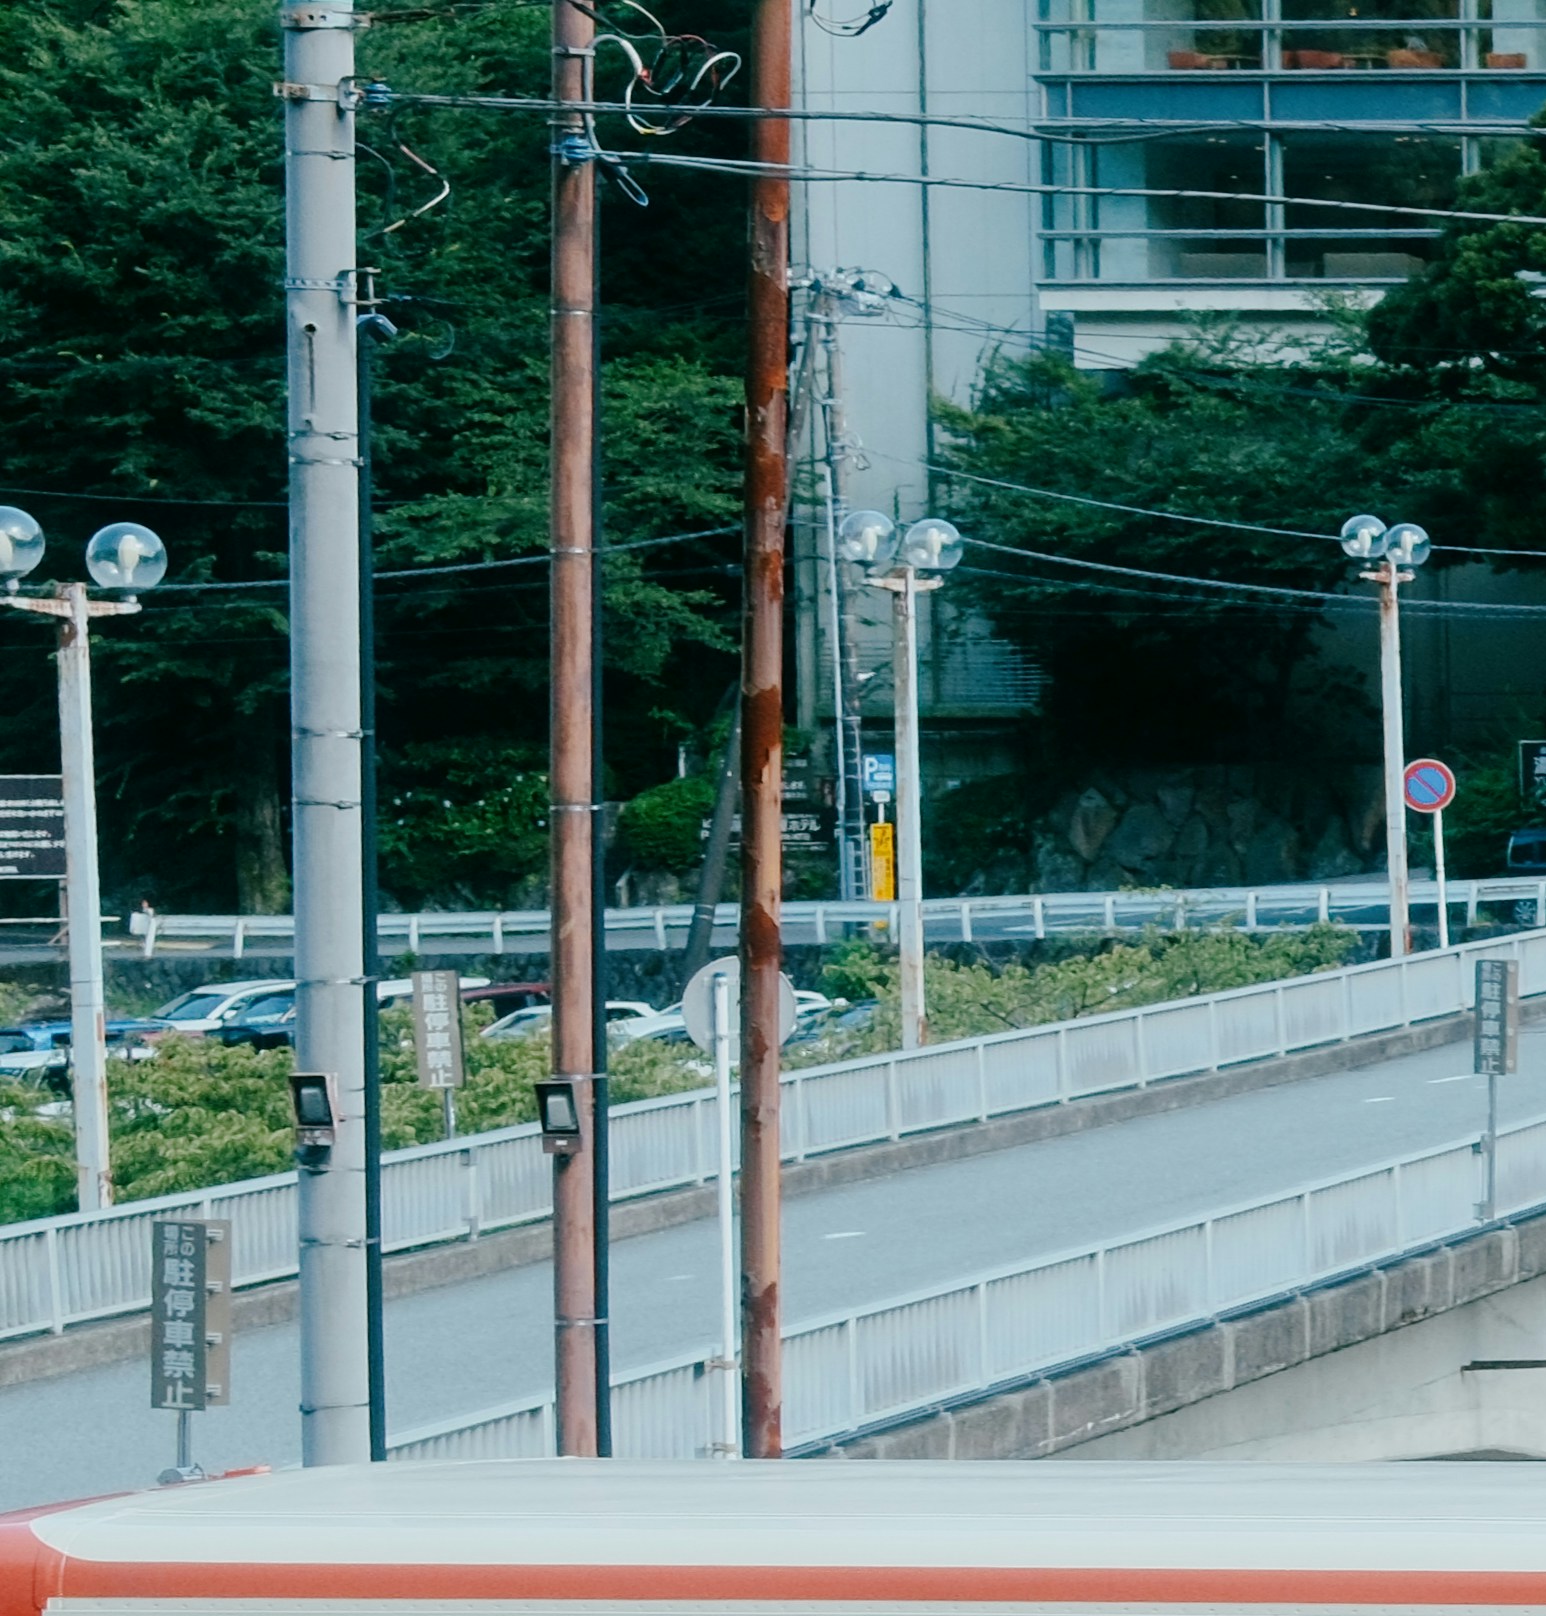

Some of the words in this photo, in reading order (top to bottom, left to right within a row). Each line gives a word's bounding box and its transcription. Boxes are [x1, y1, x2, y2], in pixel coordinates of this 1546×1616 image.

[865, 757, 878, 781] P
[162, 1257, 196, 1409] 駐停車禁止
